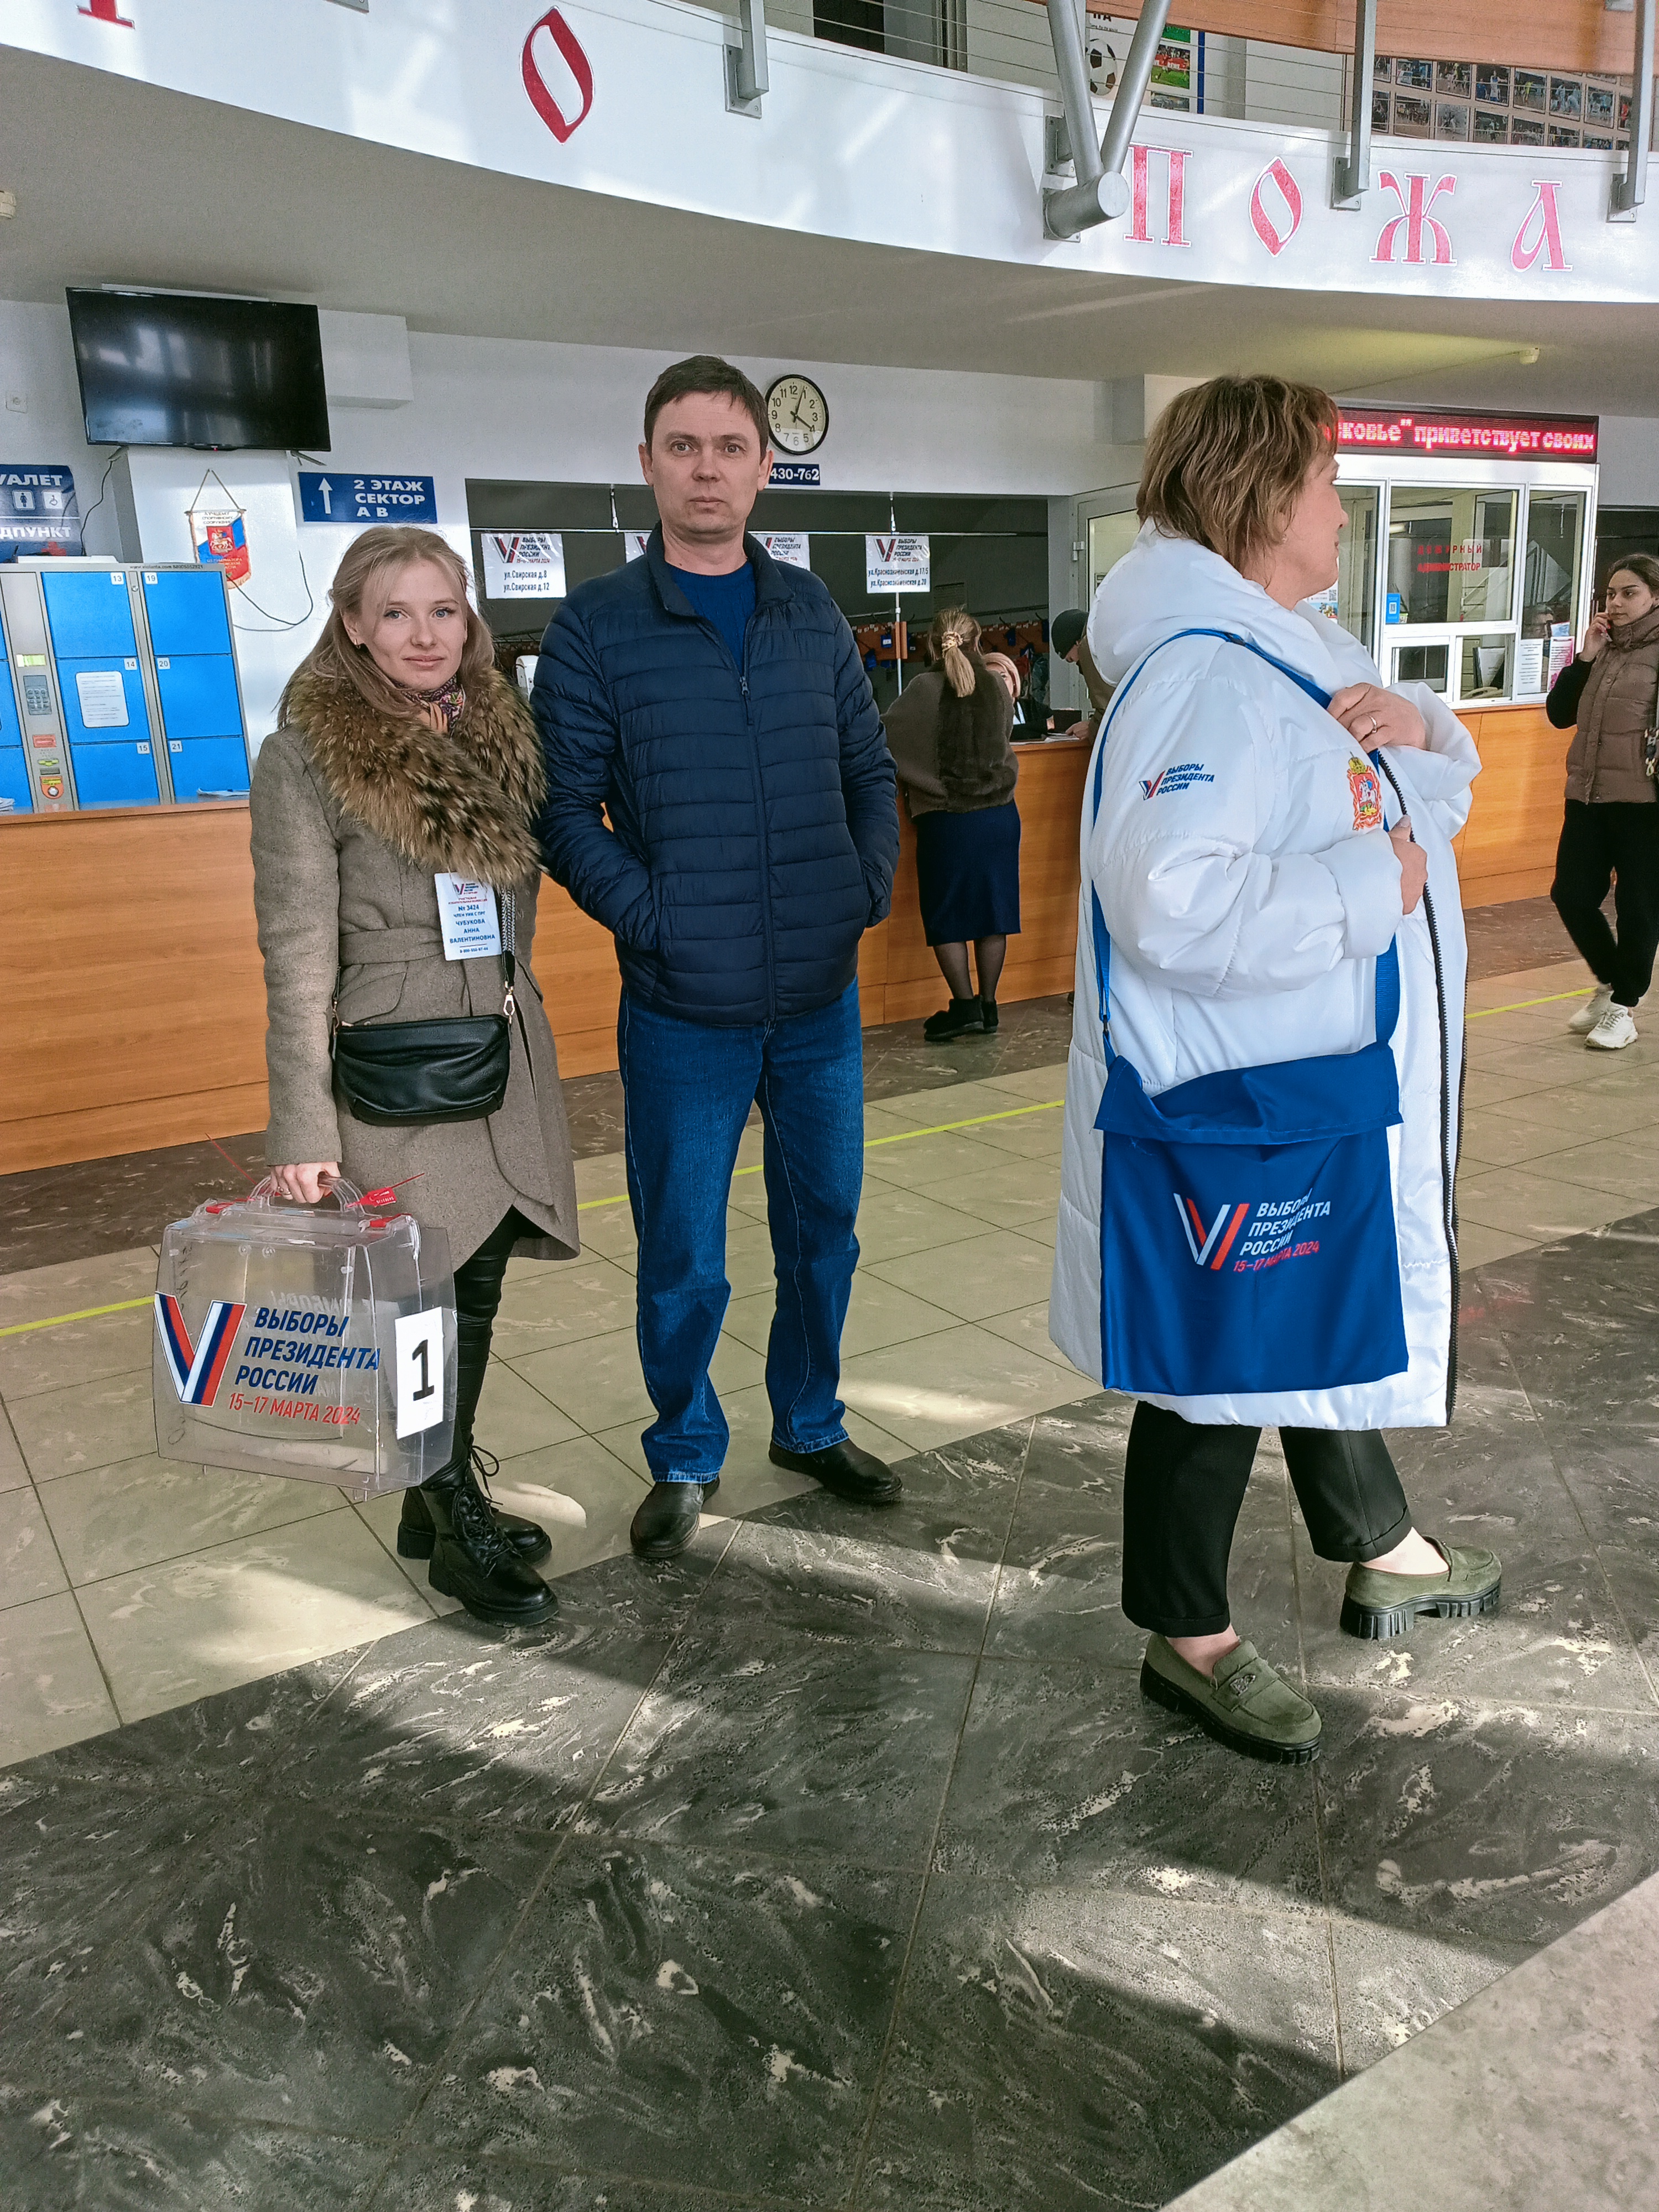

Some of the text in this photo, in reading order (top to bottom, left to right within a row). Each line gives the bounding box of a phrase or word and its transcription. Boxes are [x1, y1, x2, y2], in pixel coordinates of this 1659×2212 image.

[780, 389, 787, 398] 11
[790, 386, 797, 395] 12
[773, 398, 781, 407] 10
[810, 400, 815, 409] 2
[771, 410, 778, 419] 9
[812, 413, 818, 421] 3
[775, 424, 781, 432] 8
[784, 433, 789, 442] 7
[794, 436, 799, 446] 6
[804, 434, 809, 442] 5
[1414, 426, 1541, 453] приветствует
[1542, 432, 1595, 450] своих
[354, 480, 424, 492] 2 ЭТАЖ
[355, 493, 425, 505] СЕКТОР
[357, 507, 388, 517] А В
[538, 570, 547, 580] д.8
[538, 582, 549, 592] д.12
[1166, 764, 1204, 776] ВЫБОРЫ
[1161, 773, 1215, 785] ПРЕЗИДЕНТА
[1156, 782, 1190, 796] РОССИИ
[450, 934, 495, 943] ВАЛЕНТИНОВНА
[1248, 1201, 1331, 1237] ПРЕЗИДЕНТА
[1239, 1230, 1293, 1256] РОССИИ
[1292, 1241, 1320, 1257] 2024
[254, 1307, 349, 1337] ВЫБОРЫ
[244, 1337, 380, 1370] ПРЕЗИДЕНТА
[412, 1339, 434, 1401] 1
[234, 1365, 319, 1395] РОССИИ
[270, 1400, 319, 1421] МАРТА
[322, 1406, 361, 1425] 2024
